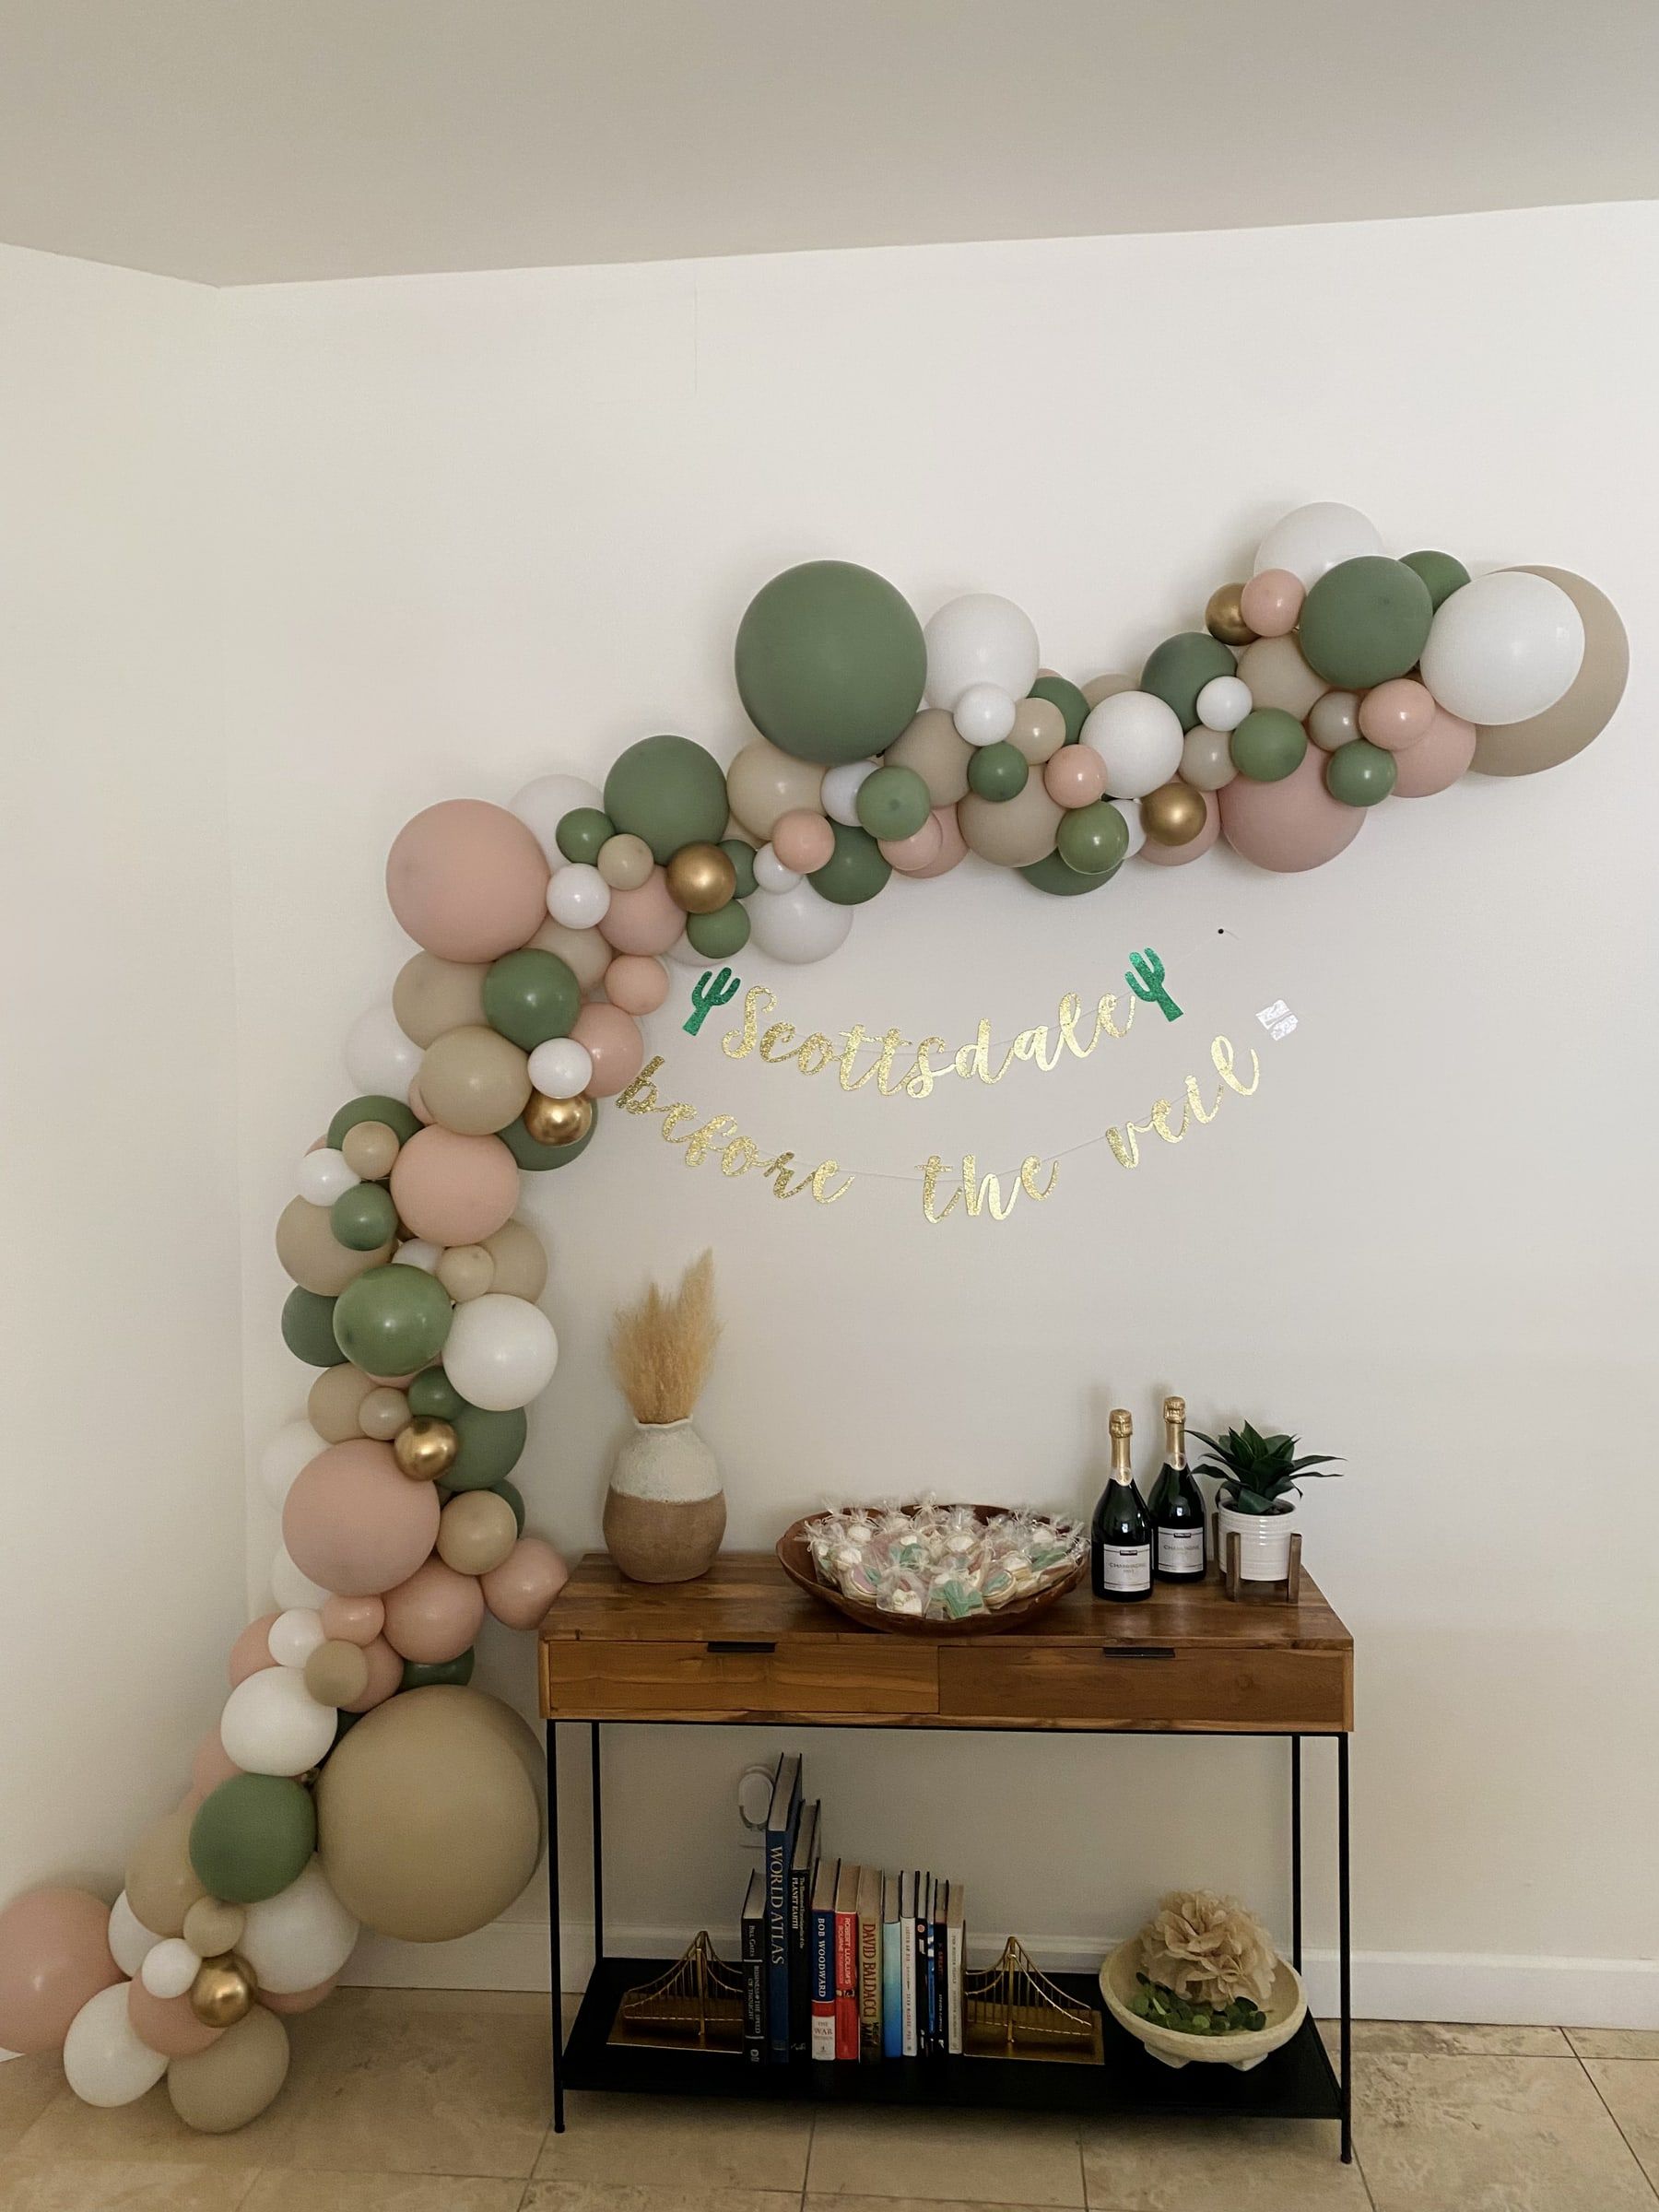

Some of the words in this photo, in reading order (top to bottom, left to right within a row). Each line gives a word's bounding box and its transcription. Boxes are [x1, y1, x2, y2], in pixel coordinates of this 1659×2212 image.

[721, 984, 1136, 1100] Scottsdale
[616, 1055, 855, 1205] before
[915, 1153, 1059, 1224] the
[1105, 1035, 1260, 1170] veil
[770, 1846, 783, 1908] WORLD
[748, 1924, 757, 1937] BILL
[748, 1938, 757, 1957] GATES
[771, 1911, 786, 1965] ATLAS
[818, 1917, 826, 1936] BOB
[862, 1923, 877, 1959] DAVID
[818, 1940, 826, 1998] WOODWARD
[862, 1961, 877, 2018] BALDACCI
